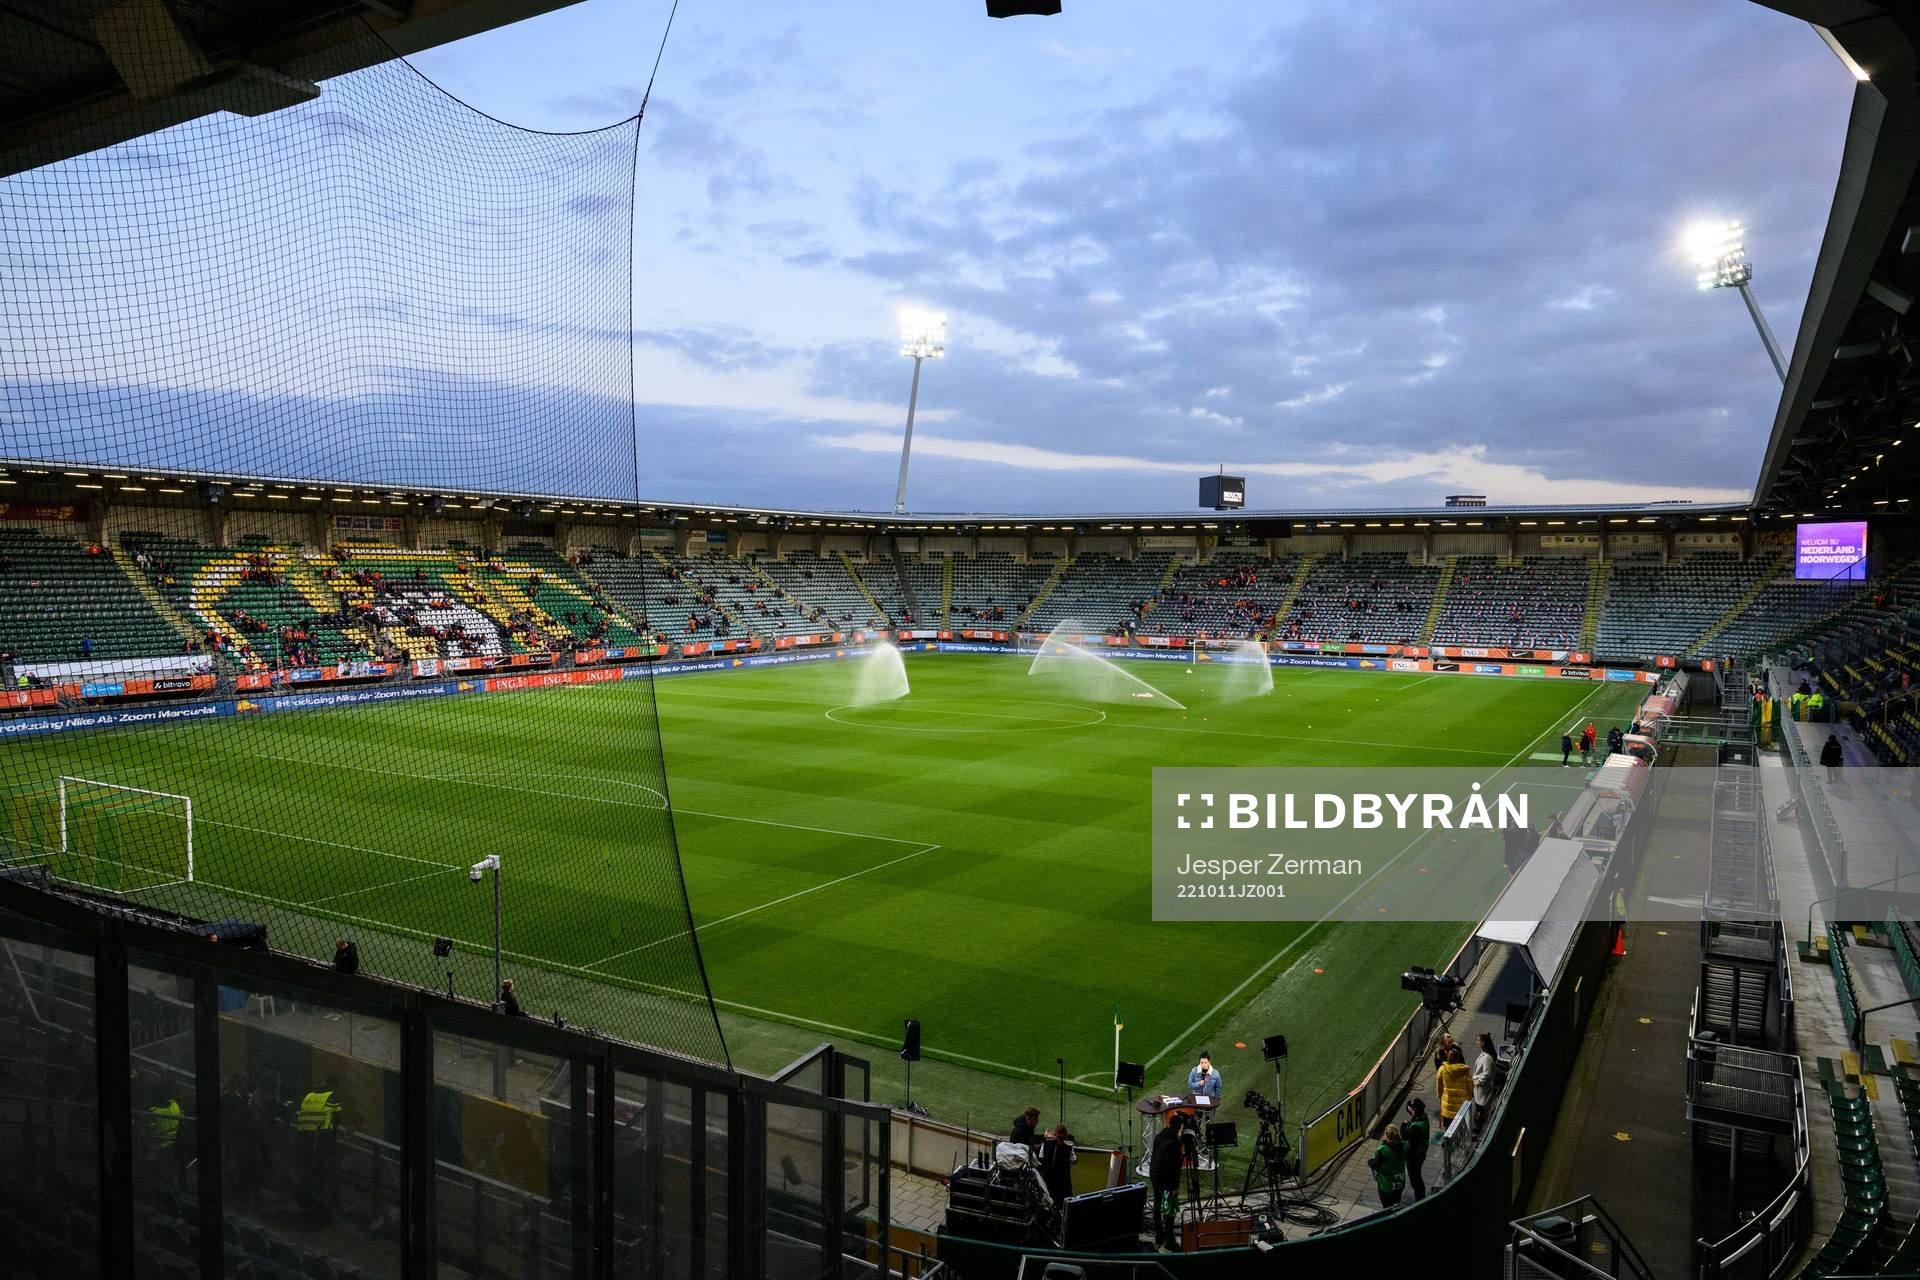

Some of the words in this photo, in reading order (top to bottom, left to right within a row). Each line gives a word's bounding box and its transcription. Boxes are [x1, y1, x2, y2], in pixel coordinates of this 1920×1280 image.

[1801, 546, 1855, 554] NEDERLAND
[1801, 555, 1859, 563] NOORWEGEN
[750, 657, 777, 665] Introducing
[586, 671, 604, 681] ING
[624, 667, 657, 677] Introducing
[1568, 669, 1590, 677] bitvavo
[162, 680, 191, 689] bitvavo
[496, 679, 517, 690] ING
[543, 675, 562, 685] ING
[276, 697, 334, 709] Introducing
[358, 692, 373, 701] Air
[374, 690, 400, 699] Zoom
[65, 717, 95, 728] Nike
[97, 714, 118, 724] Air
[119, 711, 157, 722] Zoom
